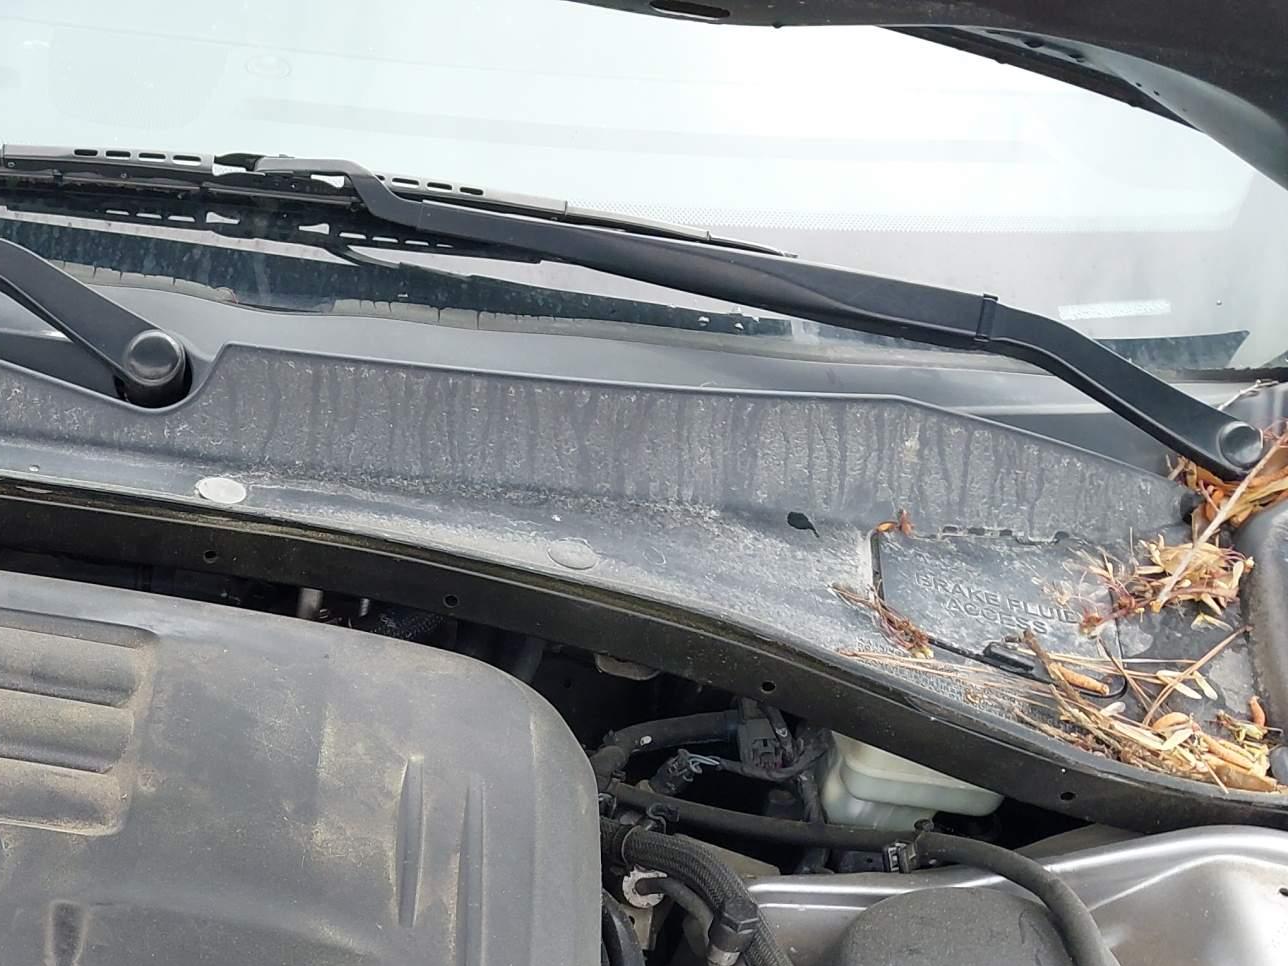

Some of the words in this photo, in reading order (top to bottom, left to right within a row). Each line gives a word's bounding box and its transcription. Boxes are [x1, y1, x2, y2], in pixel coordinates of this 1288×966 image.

[915, 572, 1001, 608] BRAKE
[1007, 598, 1083, 624] FLUID
[946, 598, 1048, 635] ACCESS
